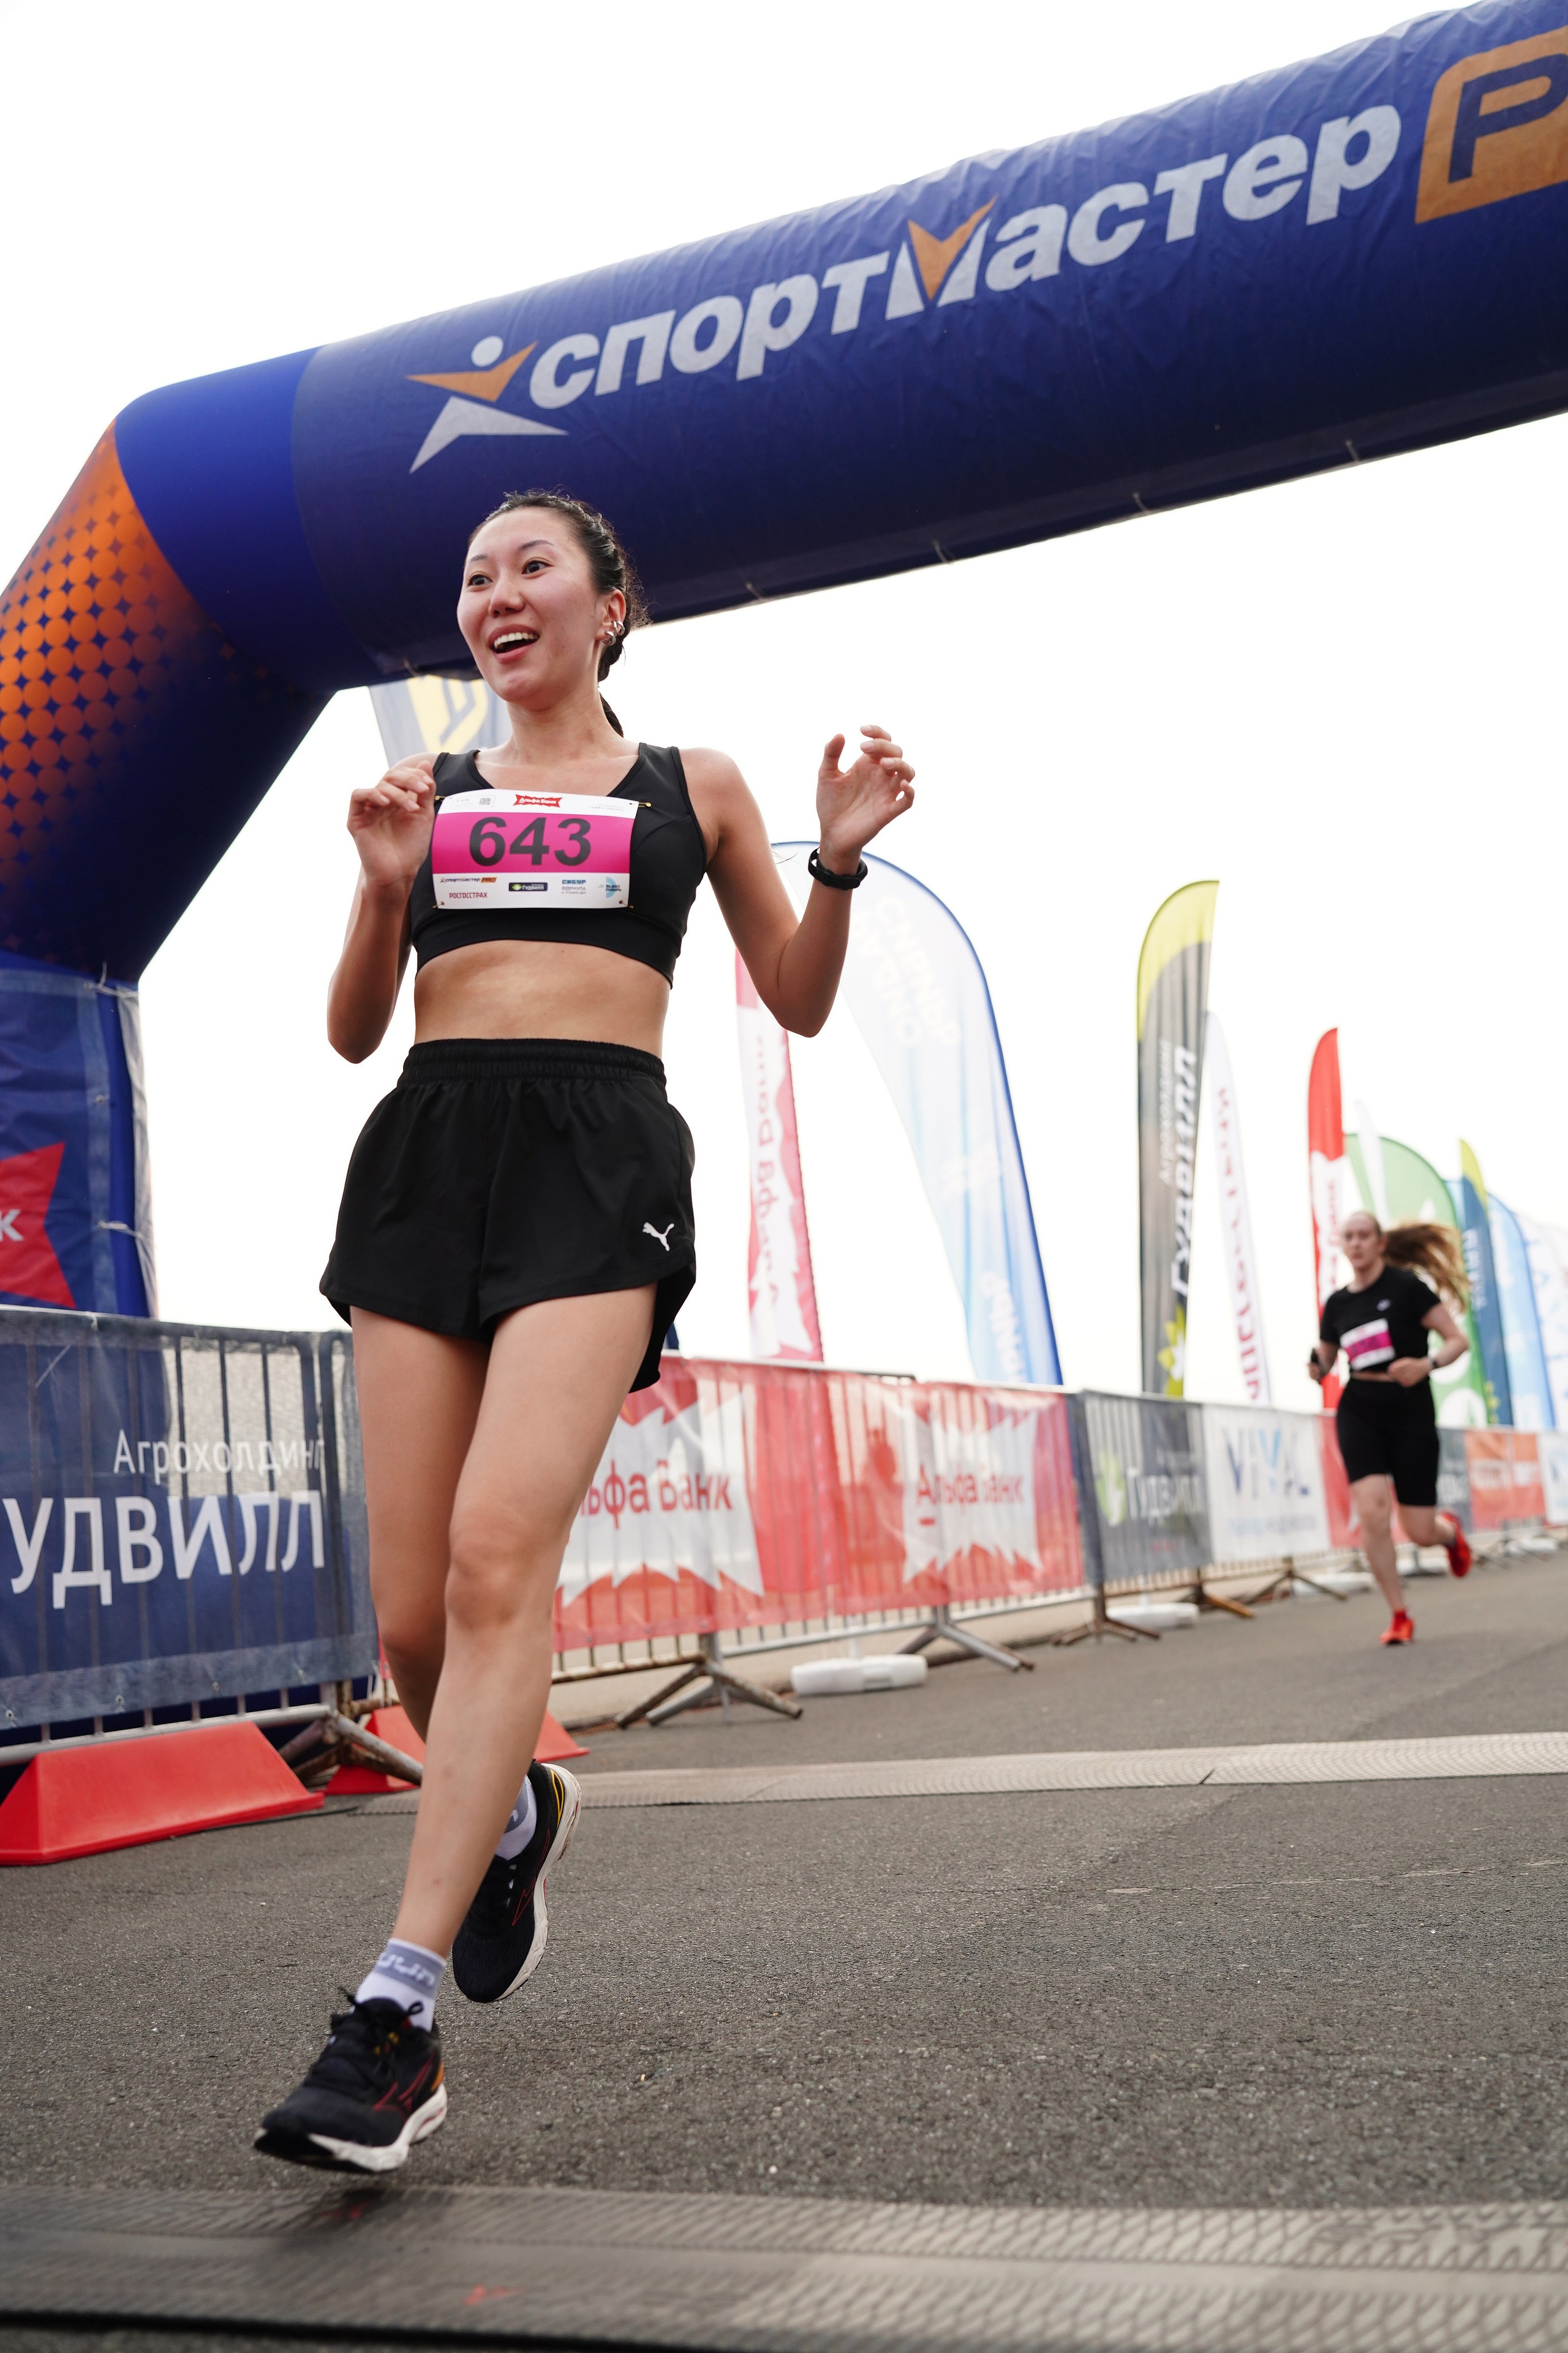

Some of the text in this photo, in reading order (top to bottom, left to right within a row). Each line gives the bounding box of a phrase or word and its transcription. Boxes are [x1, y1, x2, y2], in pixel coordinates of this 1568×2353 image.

[469, 816, 590, 866] 643
[113, 1429, 325, 1485] Агрохолдинг
[657, 1459, 732, 1512] Банк
